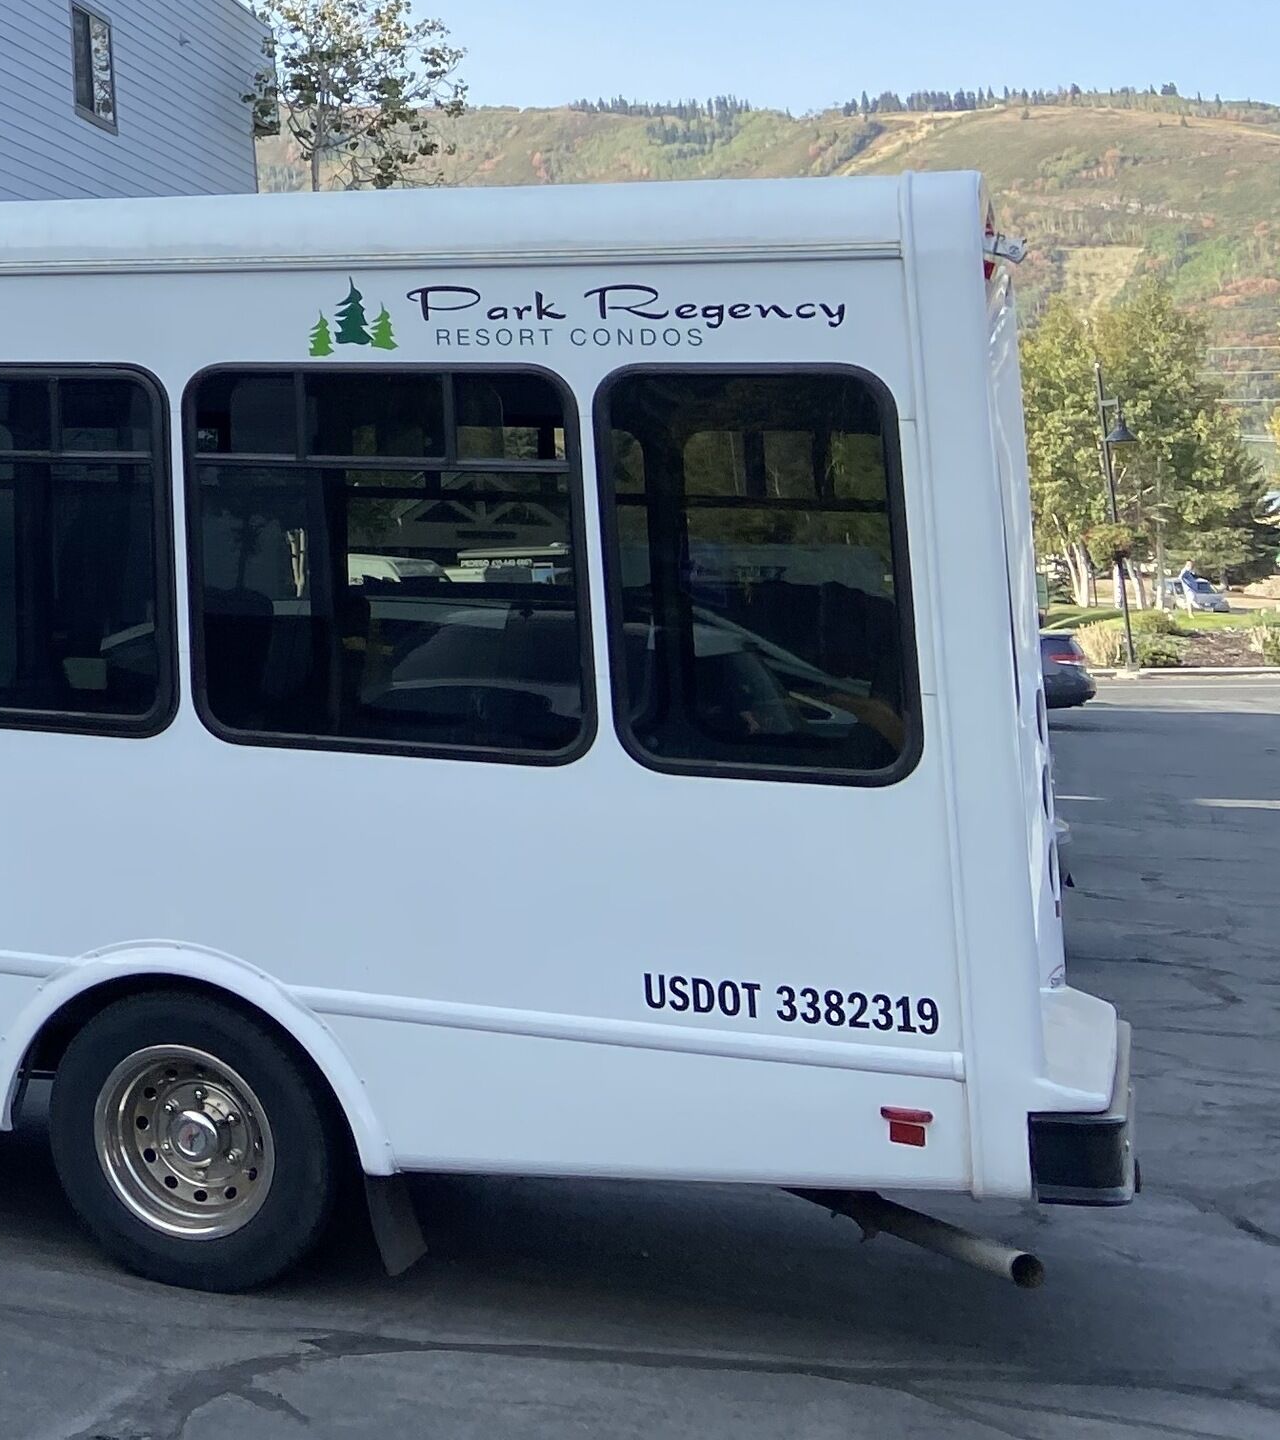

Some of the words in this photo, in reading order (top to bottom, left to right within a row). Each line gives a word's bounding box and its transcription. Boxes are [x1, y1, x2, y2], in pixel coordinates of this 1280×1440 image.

[405, 285, 567, 322] Park
[583, 284, 847, 328] Regency
[435, 328, 553, 347] RESORT
[569, 327, 705, 348] CONDOS
[643, 972, 760, 1018] USDOT
[776, 985, 940, 1035] 3382319
